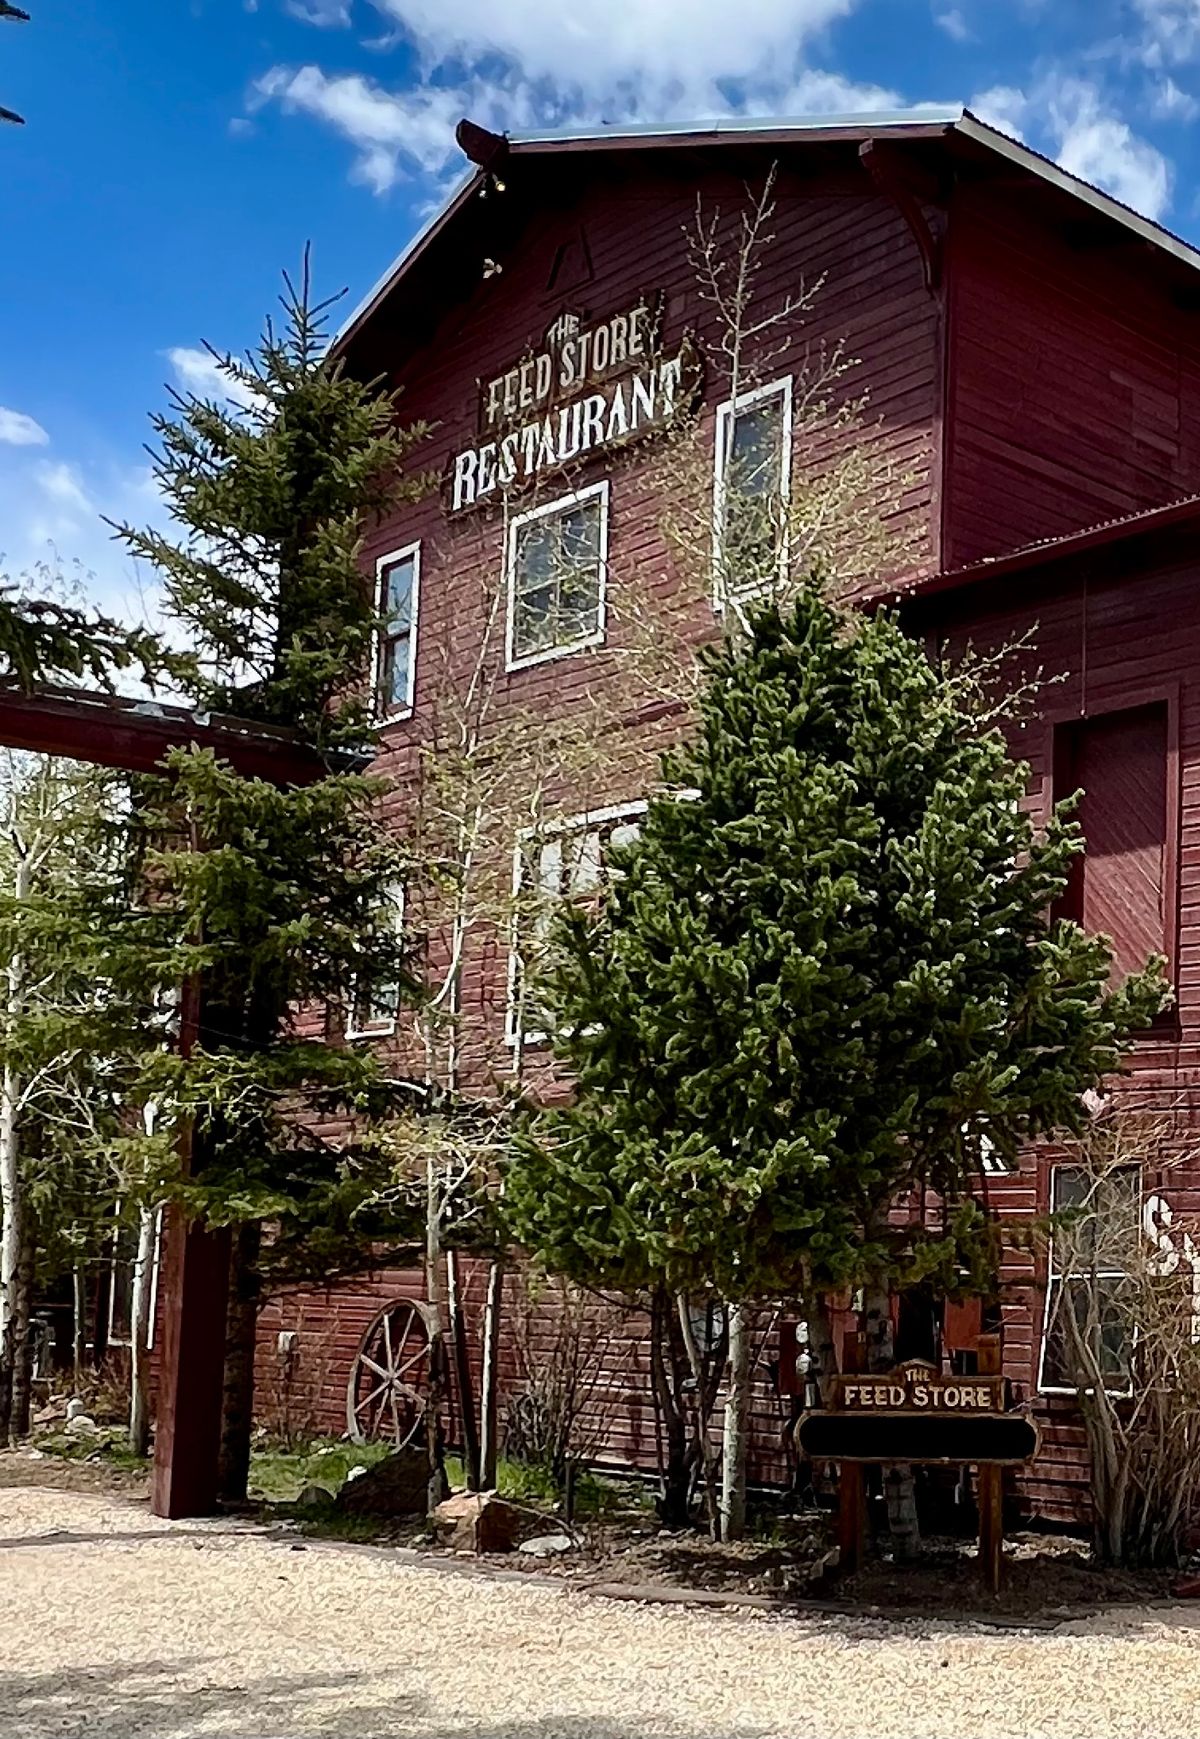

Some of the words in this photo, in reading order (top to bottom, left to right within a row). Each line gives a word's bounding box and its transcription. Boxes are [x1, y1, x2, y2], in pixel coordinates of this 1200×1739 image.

[548, 312, 580, 345] THE
[486, 353, 552, 424] FEED
[560, 306, 648, 388] STORE
[451, 357, 682, 511] RESTAURANT
[905, 1368, 931, 1383] THE
[844, 1385, 906, 1406] FEED
[913, 1384, 992, 1408] STORE
